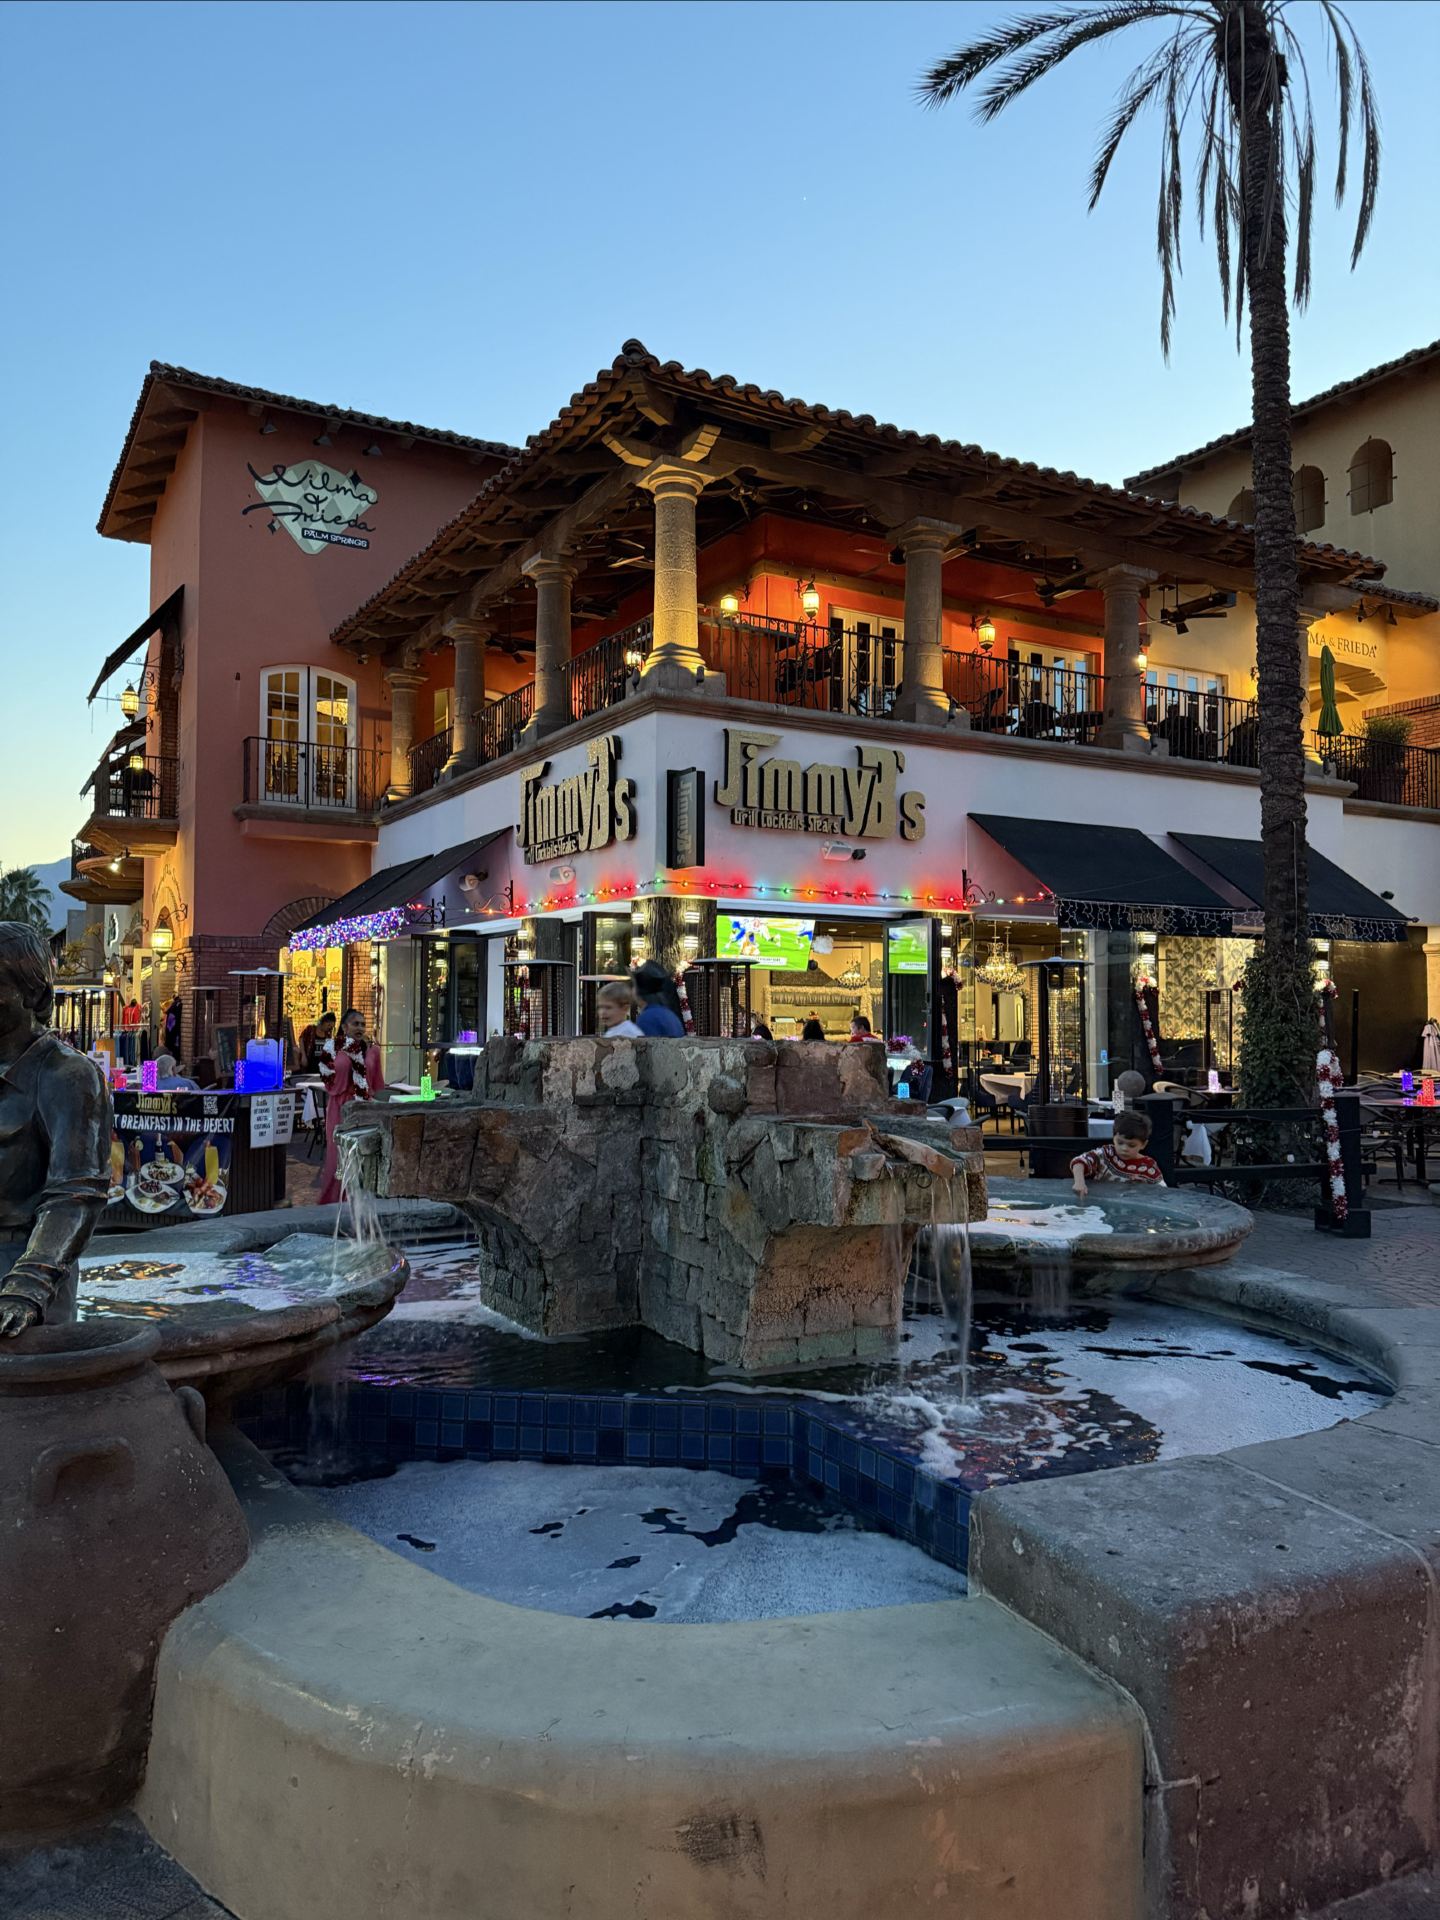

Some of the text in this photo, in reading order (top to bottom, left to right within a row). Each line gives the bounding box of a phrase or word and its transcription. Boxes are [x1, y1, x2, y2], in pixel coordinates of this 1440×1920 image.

[247, 462, 378, 505] Wilma
[242, 501, 376, 532] Frieda
[303, 529, 368, 548] PALM SPRINGS
[1309, 632, 1376, 658] MA & FRIEDA
[761, 810, 804, 831] Cocktails
[807, 815, 840, 834] Steas
[121, 1114, 171, 1131] BREAKFAST
[173, 1116, 182, 1131] IN
[185, 1117, 201, 1132] THE
[203, 1118, 235, 1133] DESERT
